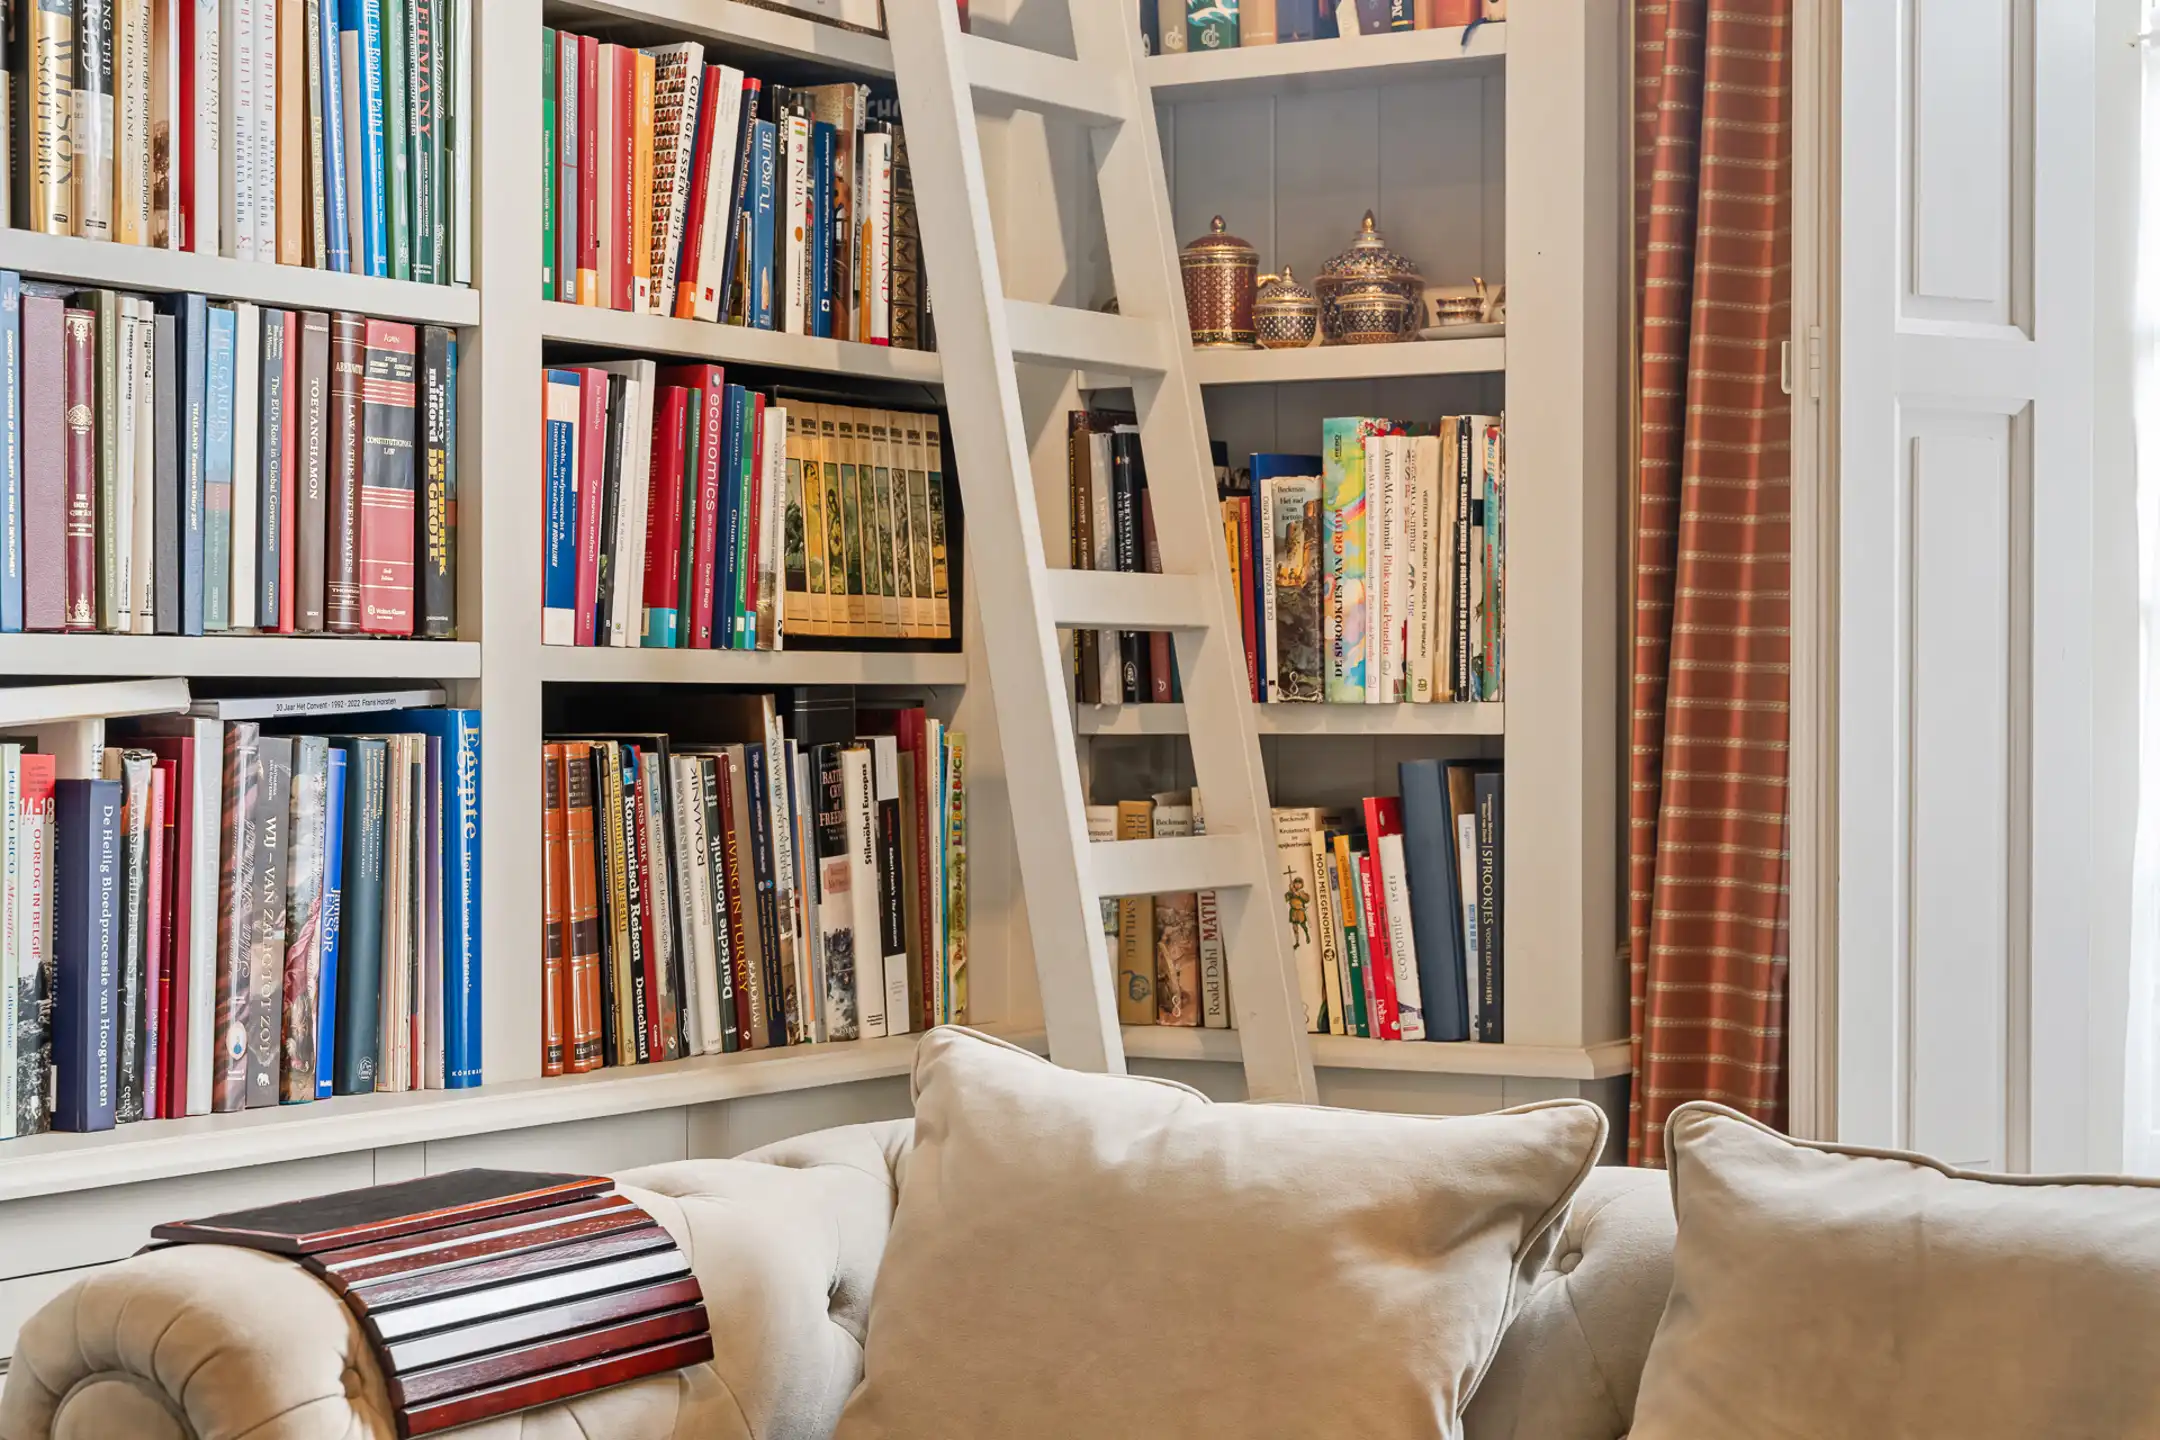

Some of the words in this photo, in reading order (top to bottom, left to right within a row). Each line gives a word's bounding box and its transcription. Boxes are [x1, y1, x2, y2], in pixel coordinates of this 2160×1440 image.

[142, 5, 150, 49] Fragen
[367, 1, 379, 20] Off
[127, 19, 135, 90] THOMAS
[369, 24, 380, 42] the
[103, 39, 112, 76] THE
[143, 52, 149, 69] an
[368, 48, 381, 91] Beaten
[127, 95, 135, 142] PAINE
[371, 99, 382, 130] Path
[684, 75, 700, 140] COLLEGE
[38, 131, 51, 184] BERG
[627, 137, 632, 153] De
[142, 153, 150, 222] Geschichte
[677, 148, 690, 196] ESSEN
[759, 130, 773, 214] TURQUIE
[795, 158, 804, 207] INDIA
[672, 207, 681, 240] 1911
[666, 257, 676, 291] 2011
[144, 329, 152, 378] Porzellan
[7, 368, 15, 384] AND
[269, 376, 279, 396] The
[346, 404, 354, 430] LAW
[429, 368, 439, 443] mitford
[269, 424, 279, 446] Role
[269, 448, 279, 457] in
[309, 377, 319, 500] TOETANCHAMON
[346, 433, 354, 443] IN
[706, 393, 720, 511] economics
[268, 461, 279, 493] Global
[345, 446, 354, 476] THE
[428, 448, 438, 480] DE
[1384, 450, 1393, 481] Annie
[7, 480, 15, 494] THE
[346, 479, 354, 526] UNITED
[268, 496, 277, 551] Governance
[428, 483, 439, 562] GROTE
[438, 449, 446, 576] FREDERIK
[1123, 491, 1132, 564] AMBASSADEUR
[1334, 507, 1343, 555] GRIMM
[7, 526, 15, 578] DEVELOPMENT
[345, 528, 353, 573] STATES
[1423, 530, 1428, 540] EN
[1265, 554, 1273, 596] PONZIANE
[1335, 557, 1343, 580] VAN
[1382, 555, 1392, 579] Pluk
[1422, 572, 1427, 581] EN
[1334, 584, 1344, 658] SPROOKJES
[1383, 602, 1391, 613] de
[1422, 611, 1427, 621] EN
[1335, 660, 1344, 677] DE
[1459, 631, 1467, 687] KLEUTERSCHOOL
[307, 702, 327, 710] Convent
[457, 726, 479, 839] Egypte
[612, 754, 619, 771] DE
[771, 736, 785, 801] ANTWERP
[7, 770, 16, 832] PUERTO
[862, 763, 870, 809] Europas
[952, 746, 962, 846] LIEDERBUCH
[103, 805, 113, 825] De
[264, 816, 277, 848] WIJ
[613, 774, 624, 873] BOERENOORLOG
[690, 768, 705, 867] ROMANIK
[8, 836, 16, 875] RICO
[32, 828, 41, 889] OORLOG
[100, 829, 113, 873] Heilig
[624, 795, 640, 899] Romantisch
[727, 830, 740, 890] LIVING
[775, 804, 787, 881] ANTWERPEN
[862, 812, 872, 865] Stilmöbel
[264, 866, 275, 903] VAN
[617, 876, 625, 890] IN
[658, 873, 665, 885] OF
[711, 836, 726, 912] Romanik
[1315, 853, 1324, 879] MOOI
[1481, 849, 1493, 925] SPROOKJES
[32, 893, 41, 907] IN
[332, 886, 341, 932] James
[618, 892, 627, 932] BEELD
[732, 895, 742, 914] IN
[1317, 881, 1332, 947] MEEGENOMEN
[31, 920, 41, 959] BELGIË
[100, 876, 111, 985] Bloedprocessie
[262, 909, 274, 968] ZALIG
[323, 893, 335, 954] ENSOR
[630, 904, 642, 962] Reisen
[720, 918, 733, 1000] Deutsche
[735, 919, 746, 991] TURKEY
[1205, 949, 1218, 978] Dahl
[1349, 932, 1359, 967] Bescherelle
[100, 990, 109, 1015] van
[260, 972, 273, 1011] TOT
[1206, 981, 1220, 1015] Roald
[1376, 999, 1386, 1024] Deltas
[125, 1028, 136, 1048] 16de
[636, 976, 648, 1059] Deutschland
[98, 1018, 109, 1108] Hoogstraten
[123, 1060, 134, 1082] 17de
